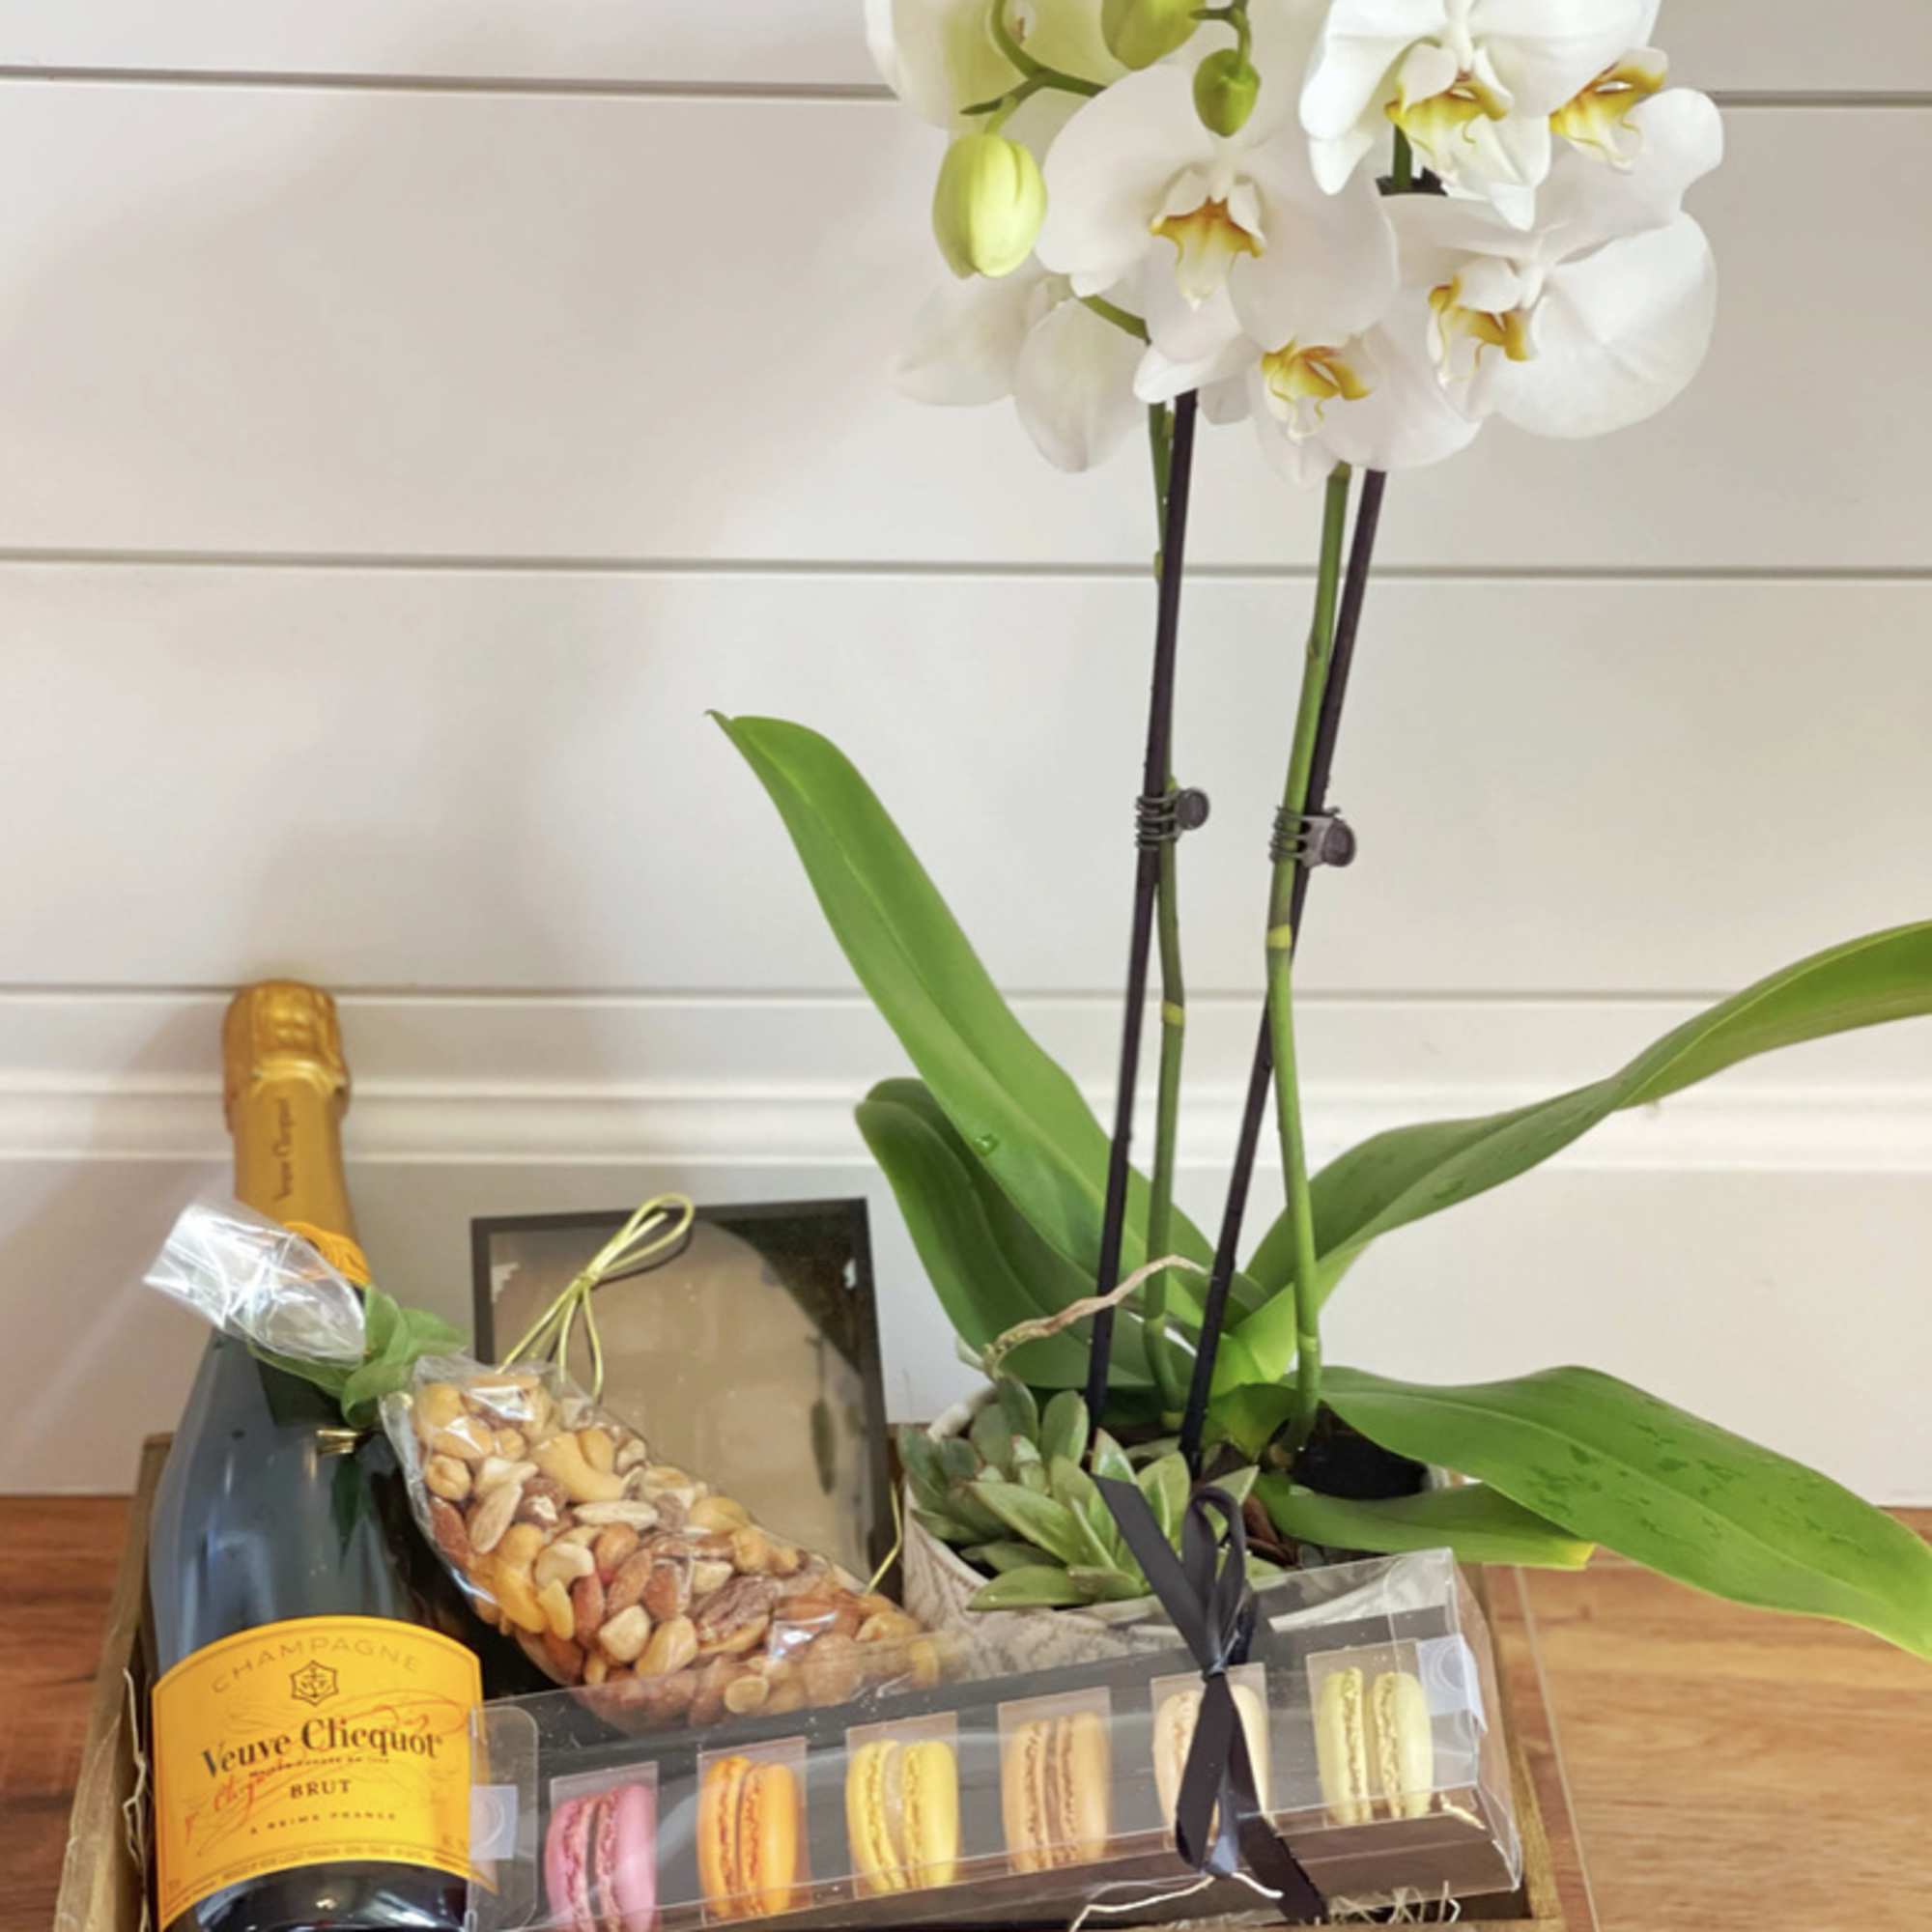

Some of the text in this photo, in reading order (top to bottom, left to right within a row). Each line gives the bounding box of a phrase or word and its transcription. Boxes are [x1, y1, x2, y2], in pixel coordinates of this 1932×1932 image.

[210, 1636, 419, 1694] CHAMPAGNE
[200, 1734, 292, 1778] Veuve
[299, 1717, 439, 1759] Clicquot
[290, 1778, 352, 1800] BRUT
